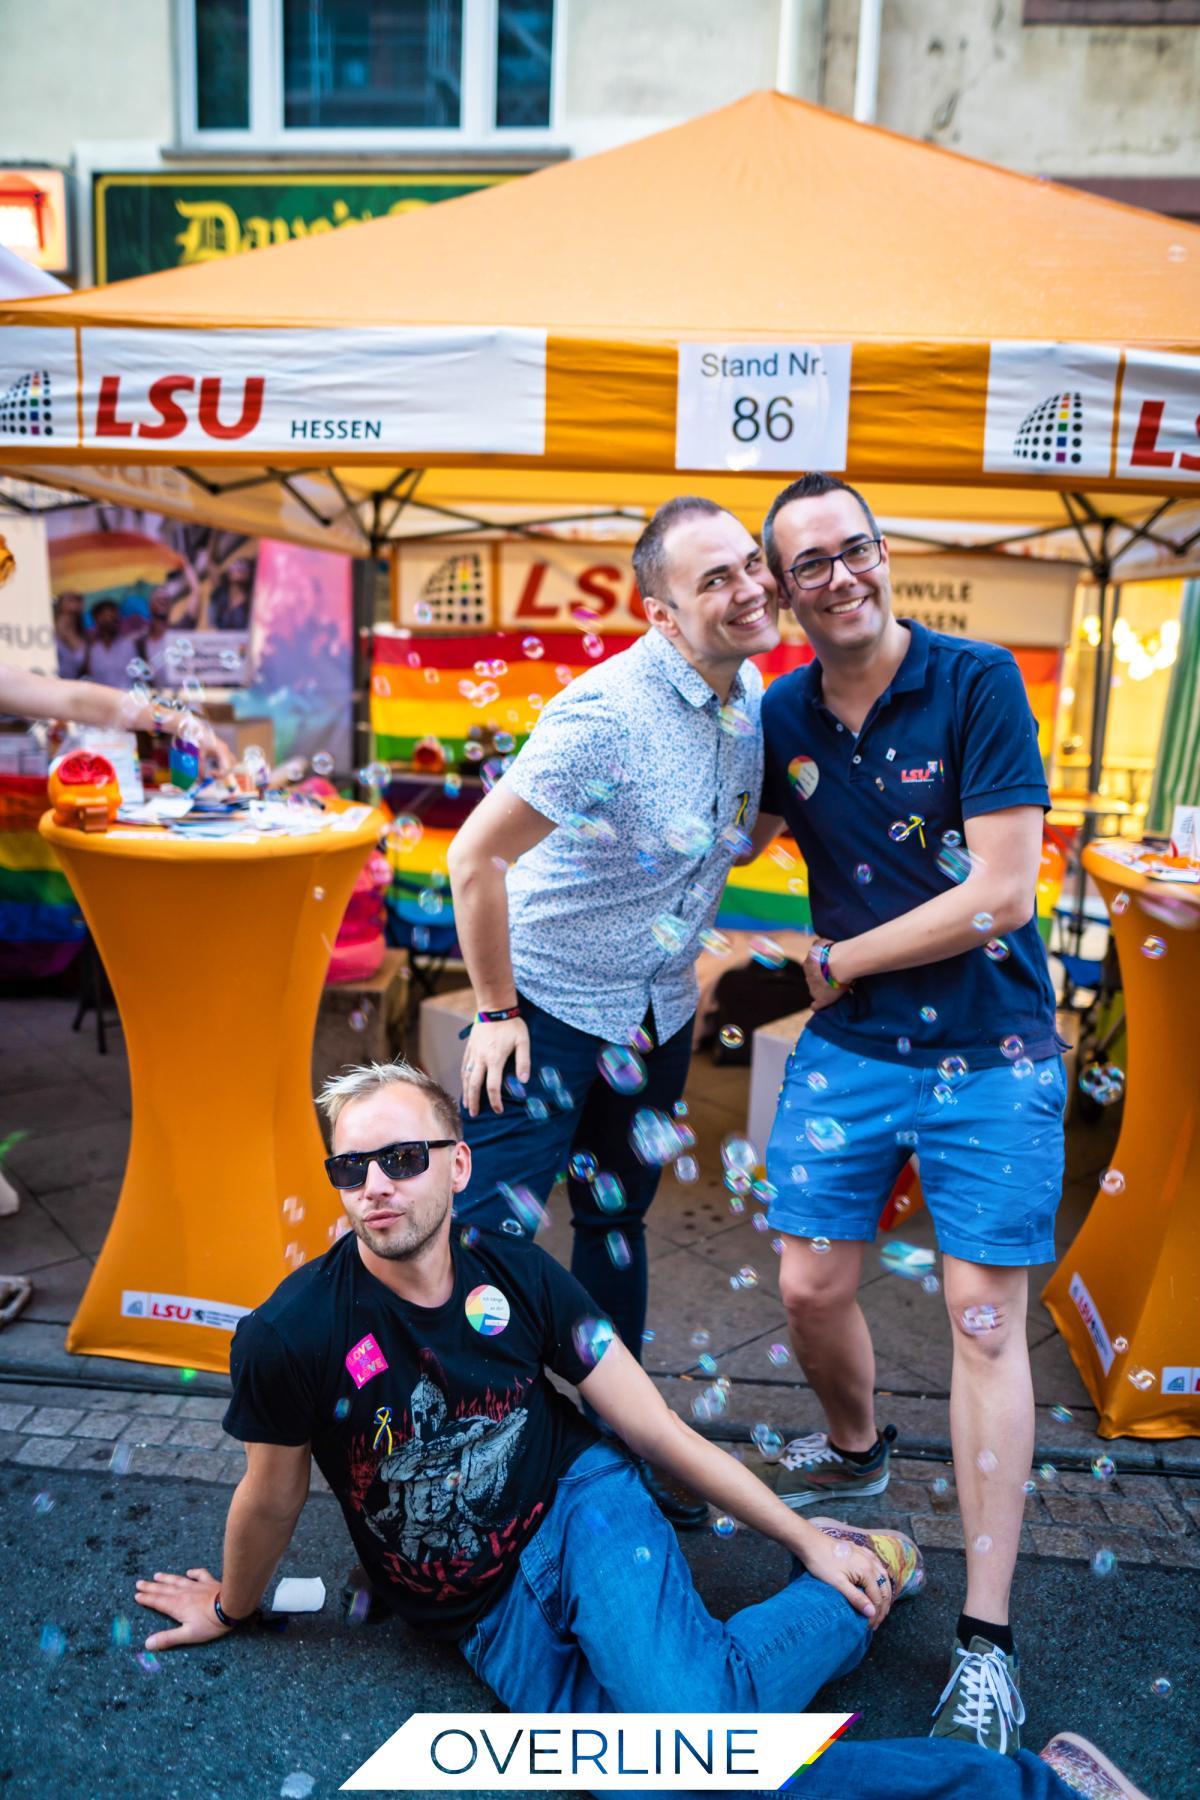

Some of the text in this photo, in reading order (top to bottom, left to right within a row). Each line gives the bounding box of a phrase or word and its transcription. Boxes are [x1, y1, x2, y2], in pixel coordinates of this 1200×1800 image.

[701, 352, 828, 377] Stand Nr.
[95, 375, 382, 440] LSU HESSEN
[732, 396, 794, 443] 86
[515, 561, 648, 624] LS
[901, 768, 930, 781] LSU
[152, 1303, 192, 1320] LSU
[356, 1357, 384, 1383] LOVE
